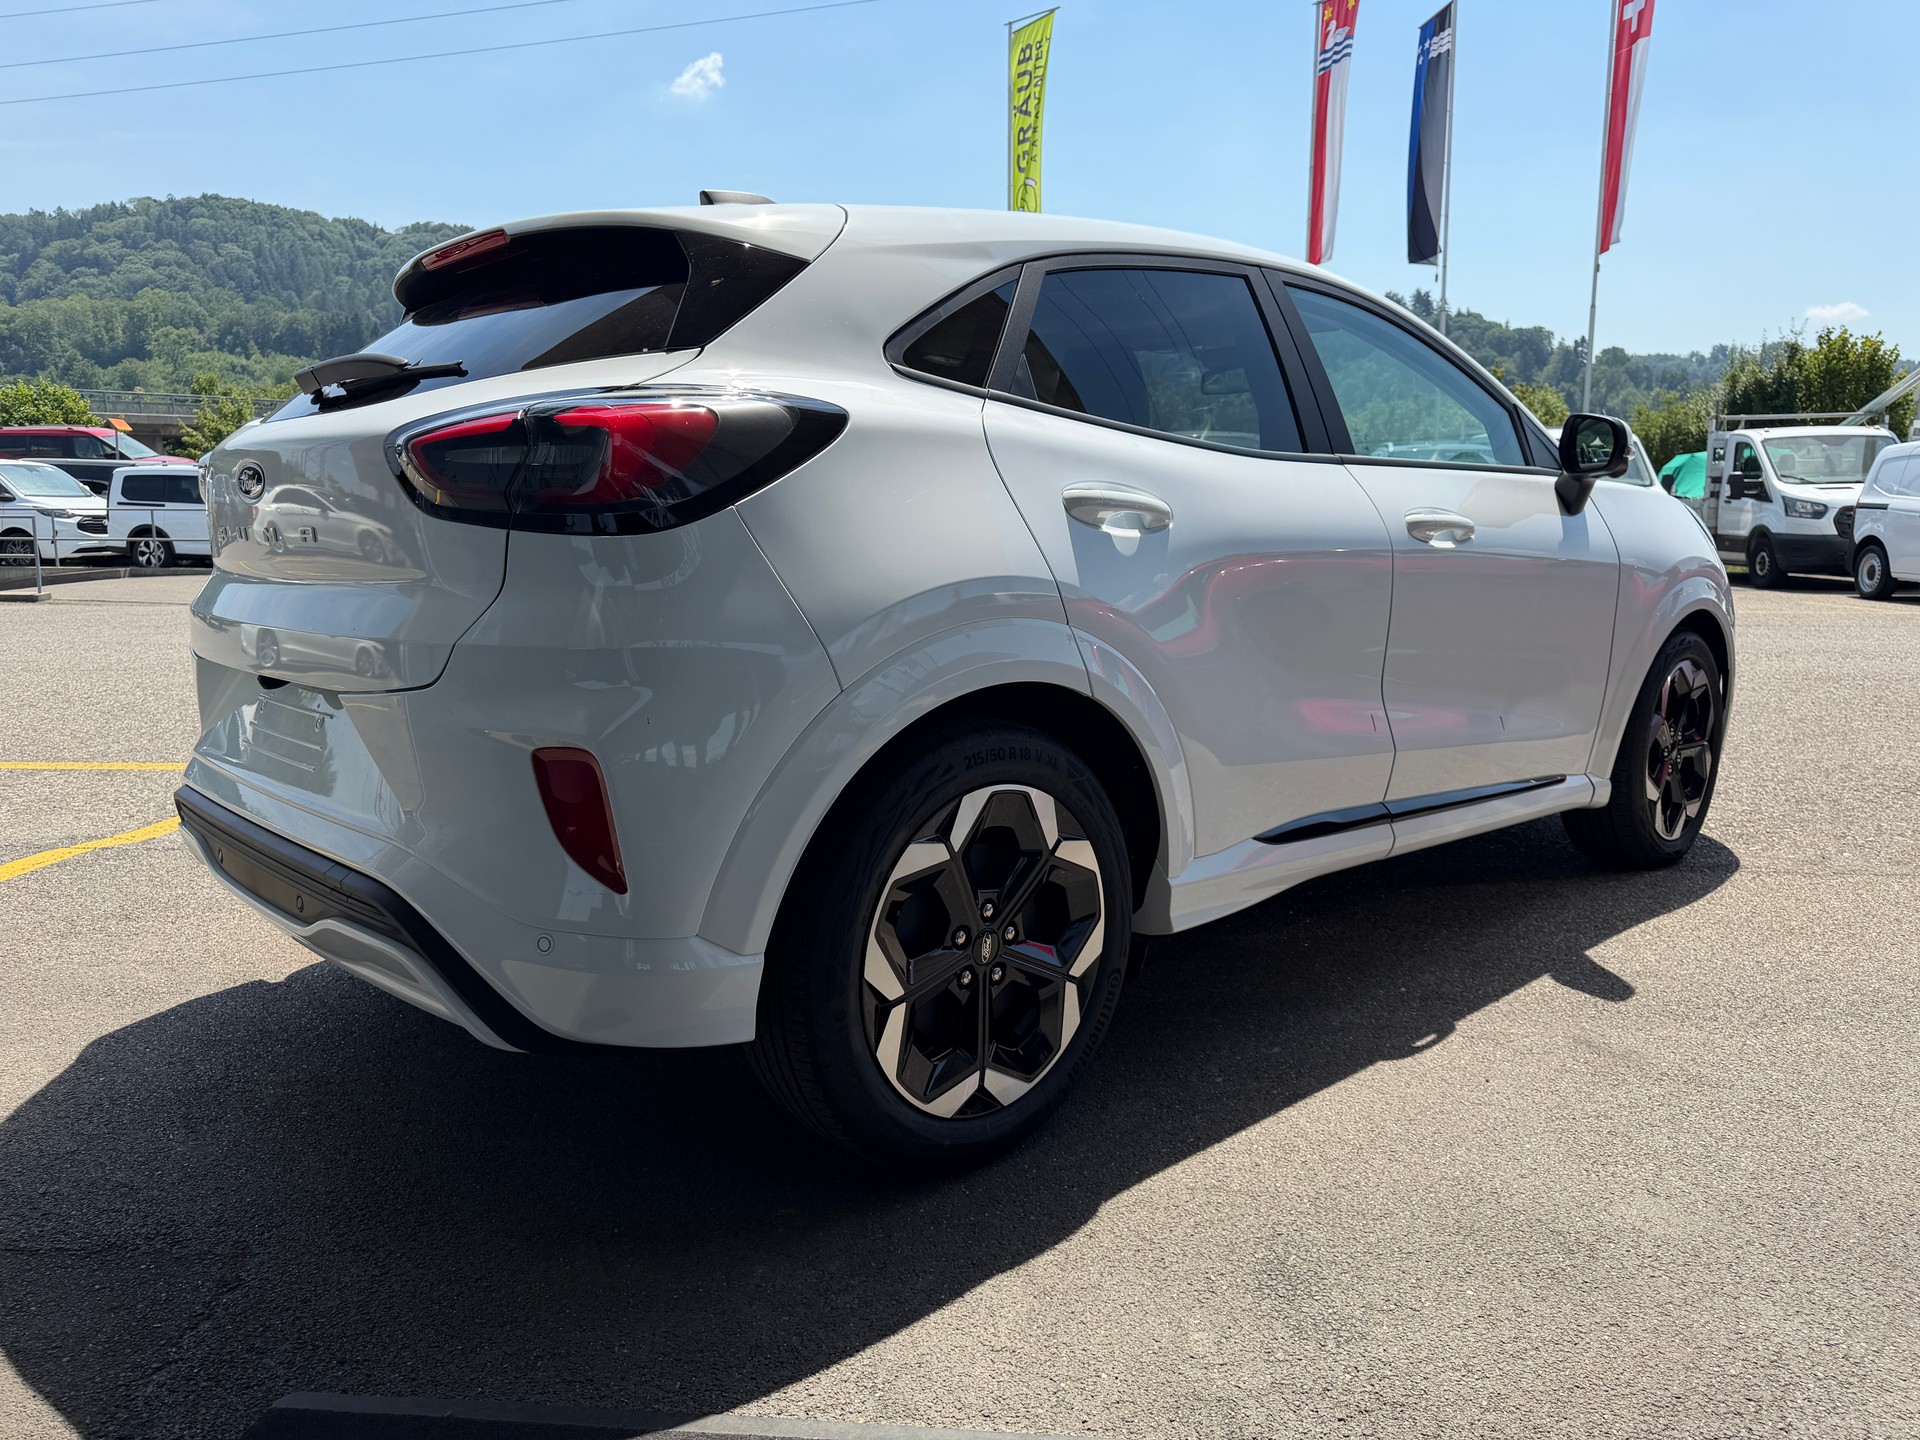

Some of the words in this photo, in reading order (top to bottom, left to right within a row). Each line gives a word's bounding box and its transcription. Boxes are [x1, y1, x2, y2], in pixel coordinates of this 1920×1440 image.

[1013, 42, 1033, 174] GRÄUB
[238, 468, 264, 495] Ford
[964, 747, 1006, 771] 215/50
[1008, 746, 1017, 760] R
[1018, 746, 1031, 760] 18
[1035, 748, 1043, 763] V
[1045, 752, 1059, 770] XL
[1067, 967, 1122, 1084] Continental
